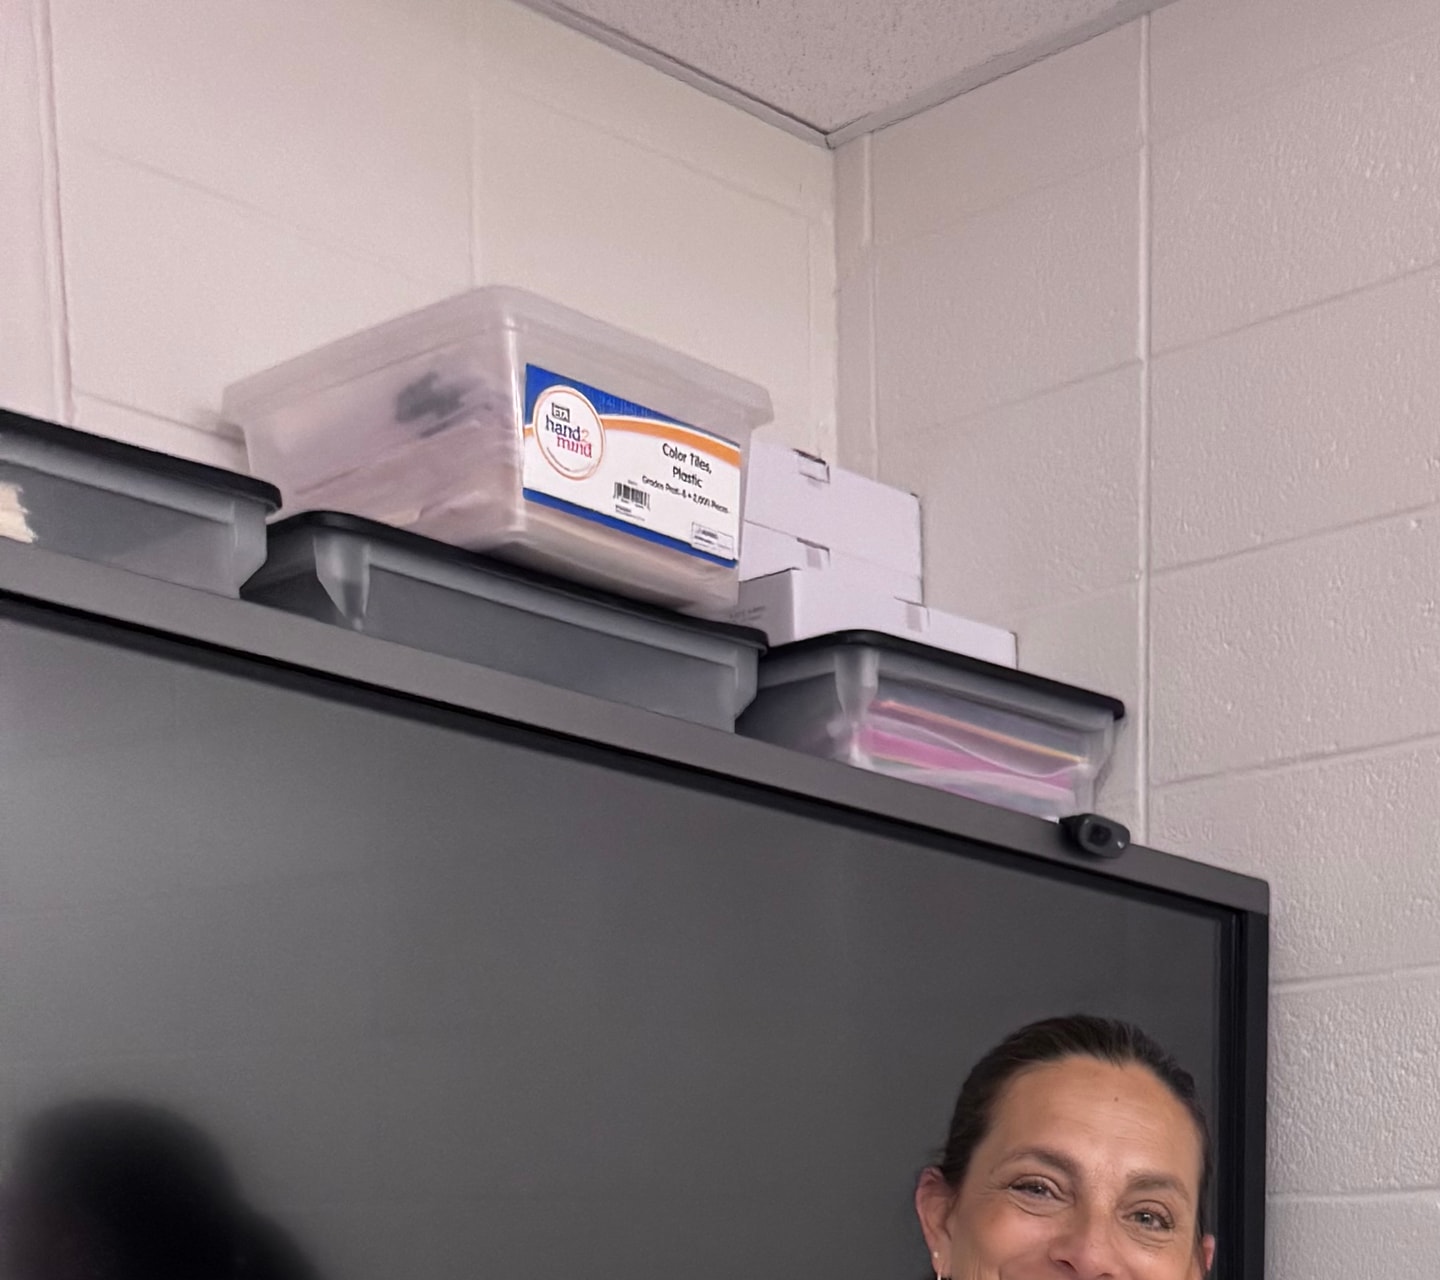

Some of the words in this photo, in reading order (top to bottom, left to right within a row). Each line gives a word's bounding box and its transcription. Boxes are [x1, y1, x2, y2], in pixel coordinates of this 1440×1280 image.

[556, 436, 592, 458] mind
[662, 443, 687, 463] Color
[672, 466, 703, 488] Plastic
